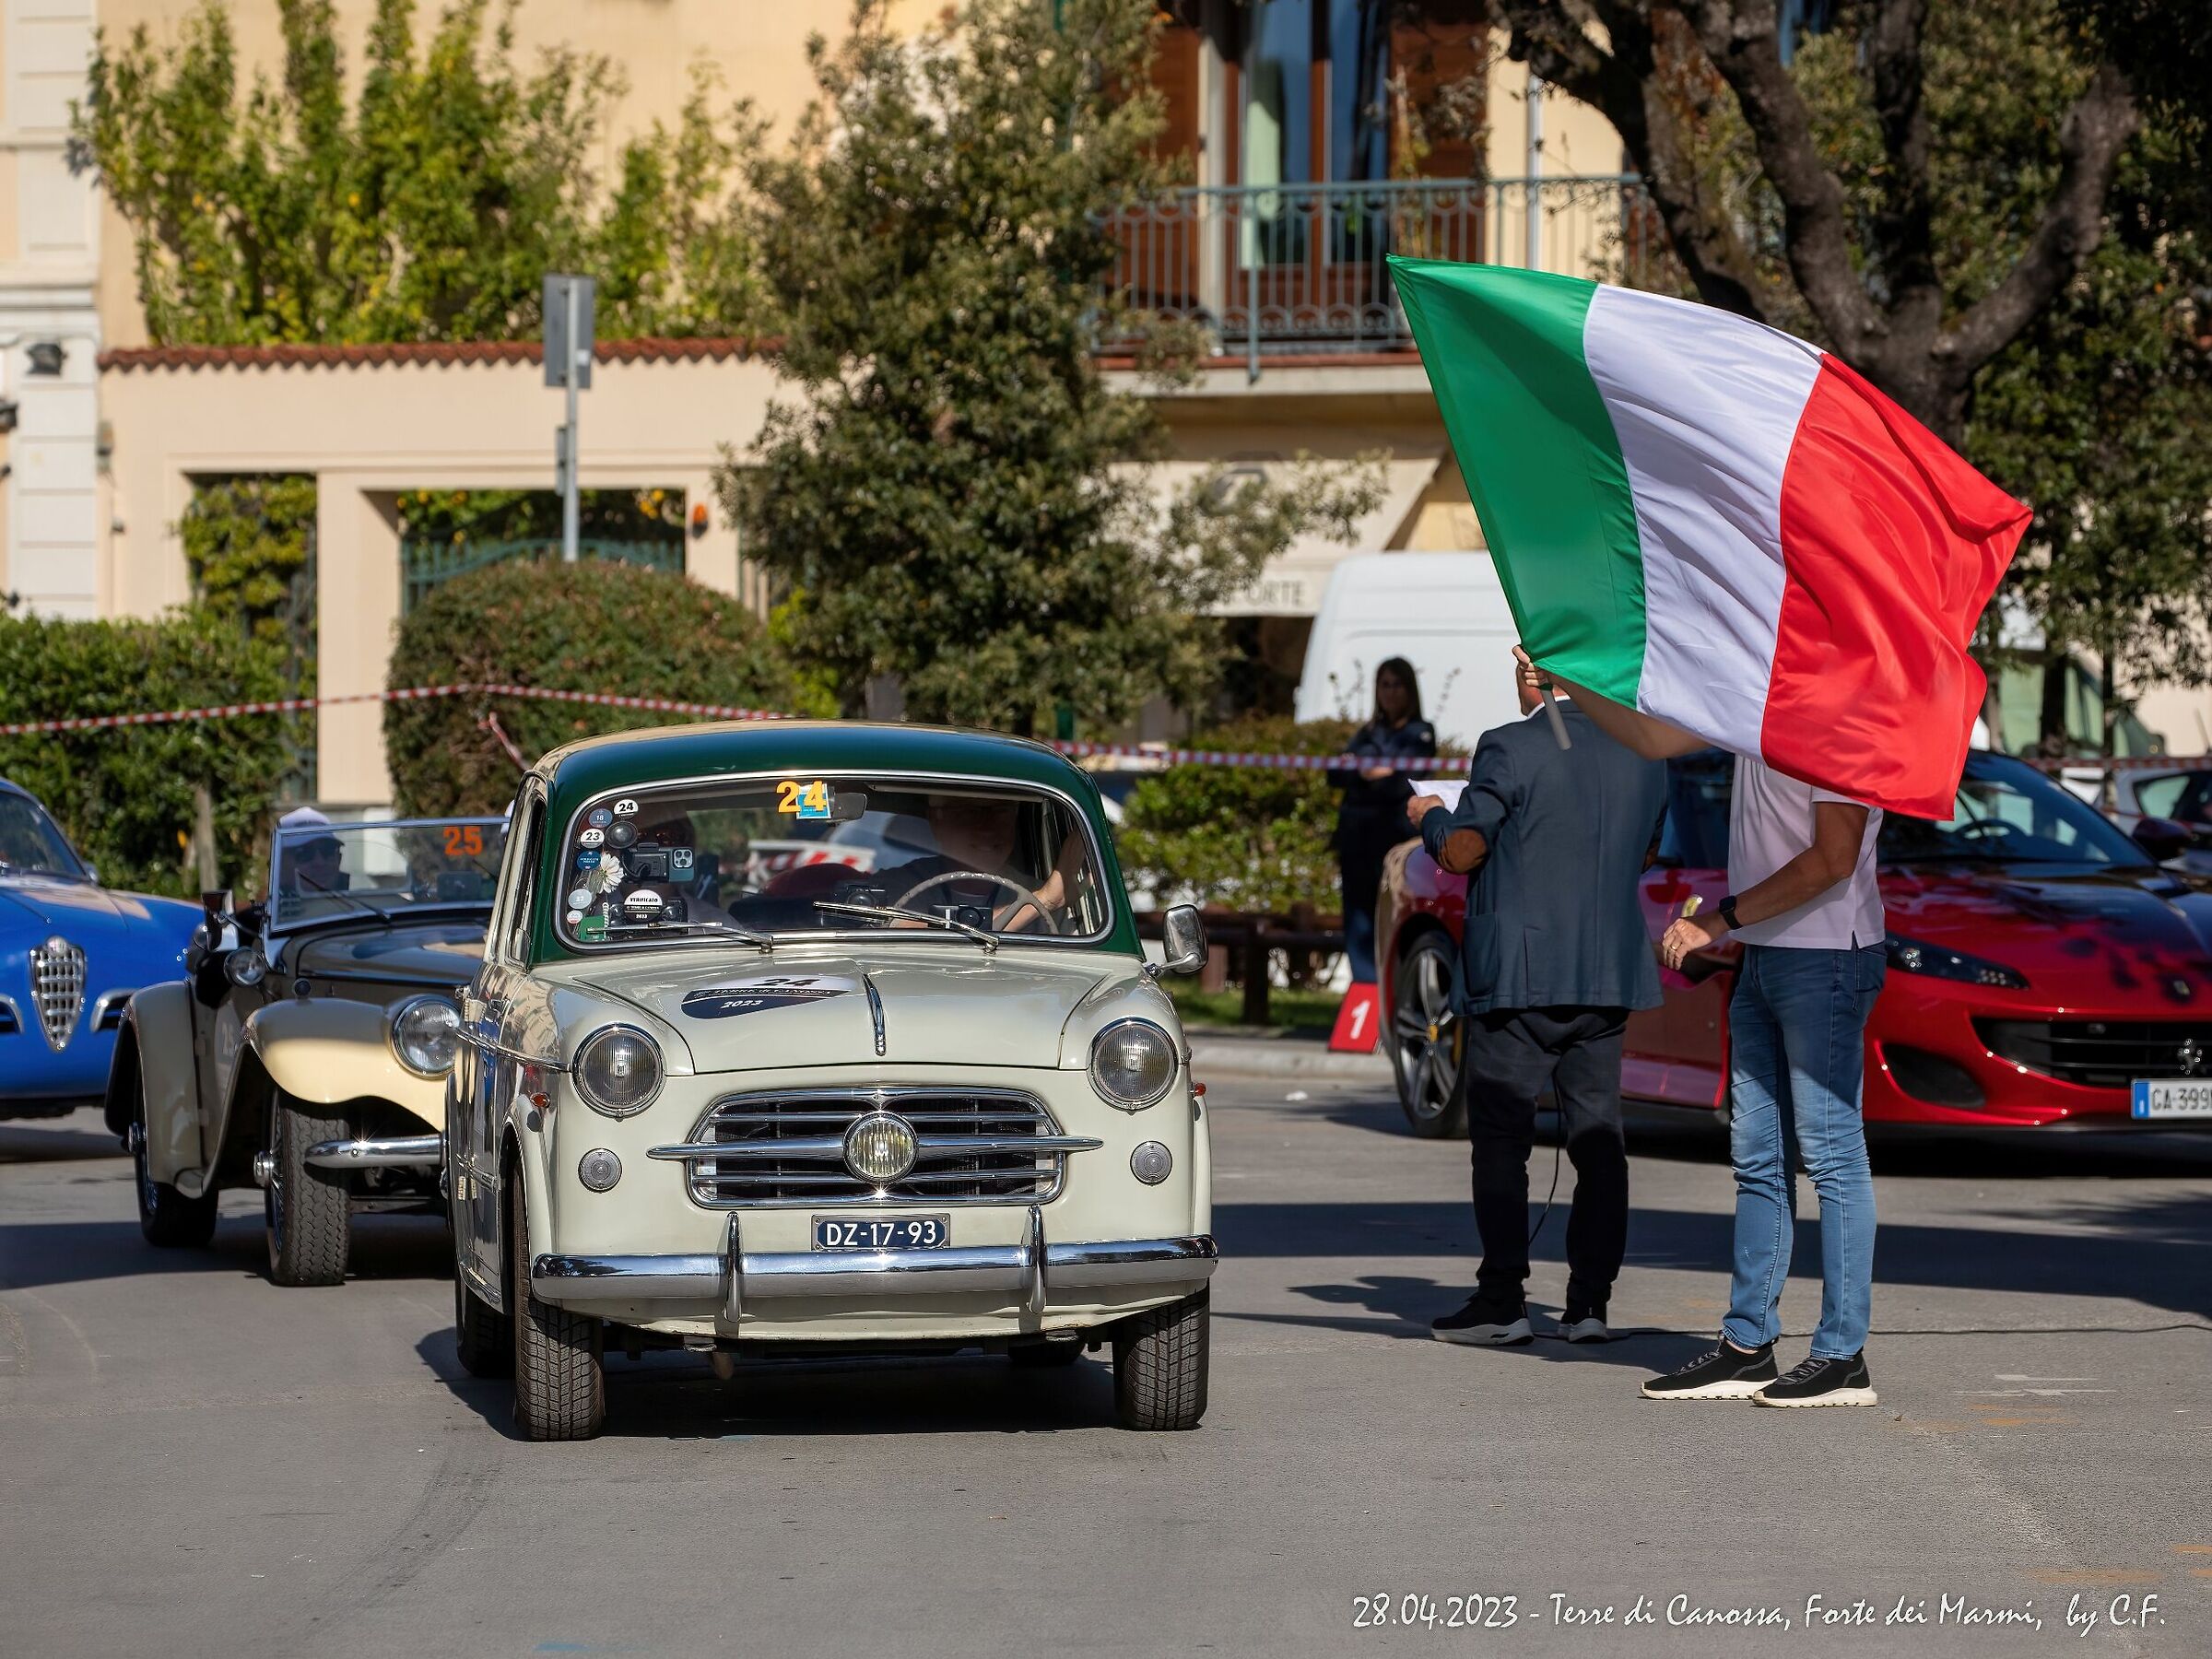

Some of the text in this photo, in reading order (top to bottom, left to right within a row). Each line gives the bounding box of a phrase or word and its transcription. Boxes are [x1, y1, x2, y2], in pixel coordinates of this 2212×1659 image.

[1232, 580, 1306, 606] ORTE
[618, 802, 634, 812] 24
[776, 780, 827, 813] 24
[443, 826, 483, 855] 25
[585, 831, 601, 841] 23
[753, 978, 821, 987] 24
[720, 999, 764, 1009] 2023
[1349, 999, 1371, 1040] 1
[826, 1220, 937, 1246] DZ-17-93
